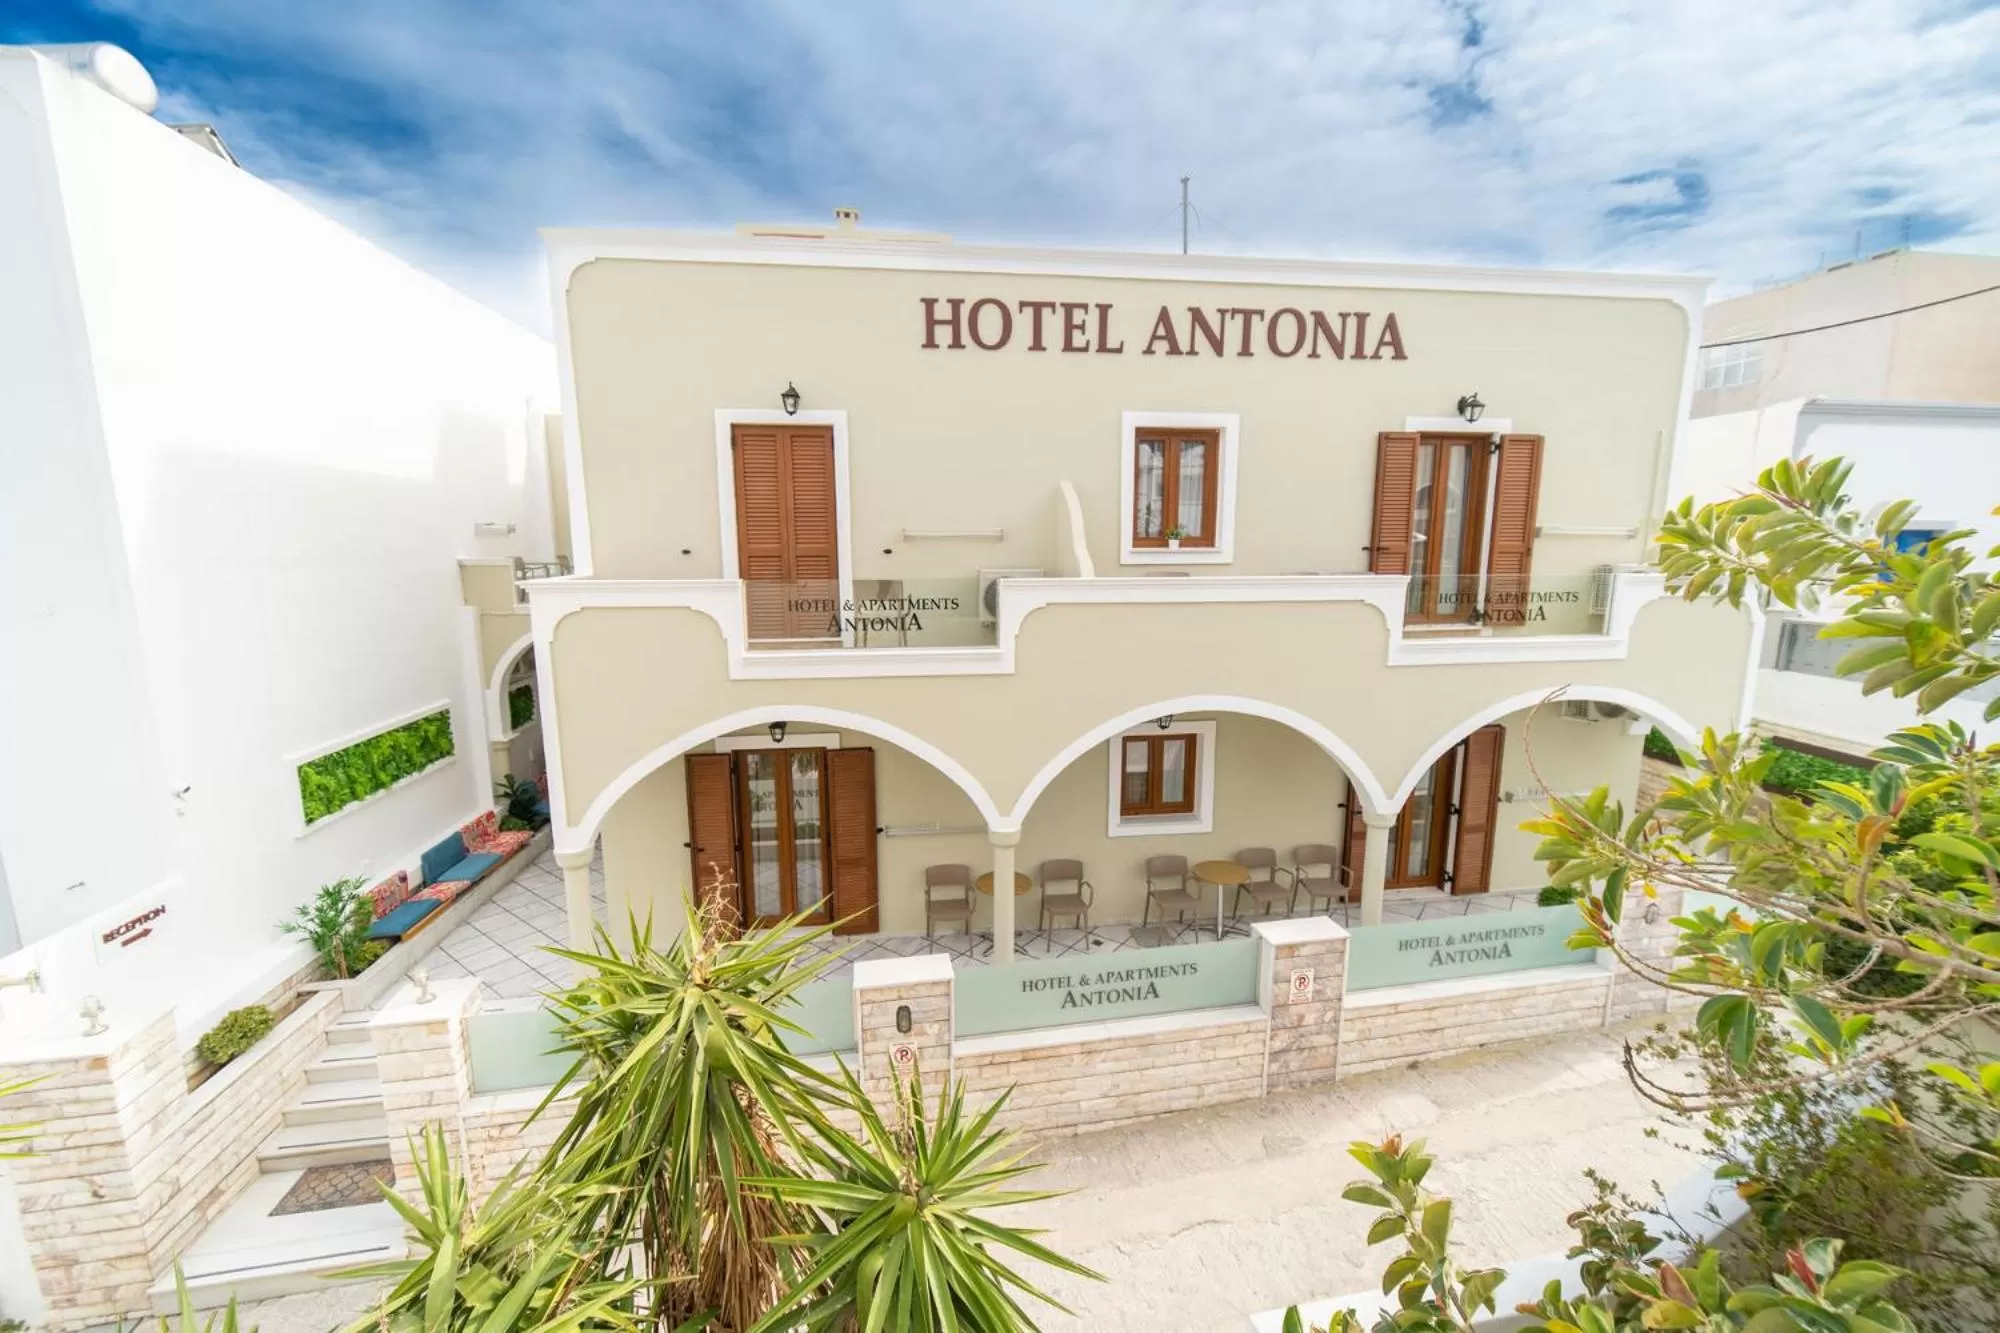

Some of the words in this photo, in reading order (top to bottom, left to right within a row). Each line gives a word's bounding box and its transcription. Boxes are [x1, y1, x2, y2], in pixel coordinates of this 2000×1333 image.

[920, 297, 1125, 354] HOTEL
[1141, 305, 1409, 361] ANTONIA
[788, 599, 839, 612] HOTEL
[843, 599, 854, 612] &
[858, 596, 960, 612] APARTMENTS
[1495, 591, 1579, 604] APARTMENTS
[827, 612, 923, 632] ANTONIA
[1469, 605, 1546, 624] ANTONIA
[102, 904, 166, 944] RECEPTION
[1398, 936, 1442, 951] HOTEL
[1445, 935, 1456, 946] &
[1459, 924, 1545, 945] APARTMENTS
[1429, 941, 1512, 967] ANTONIA
[1022, 975, 1075, 993] HOTEL
[1079, 974, 1091, 987] &
[1094, 962, 1198, 985] APARTMENTS
[1061, 981, 1160, 1009] ANTONIA
